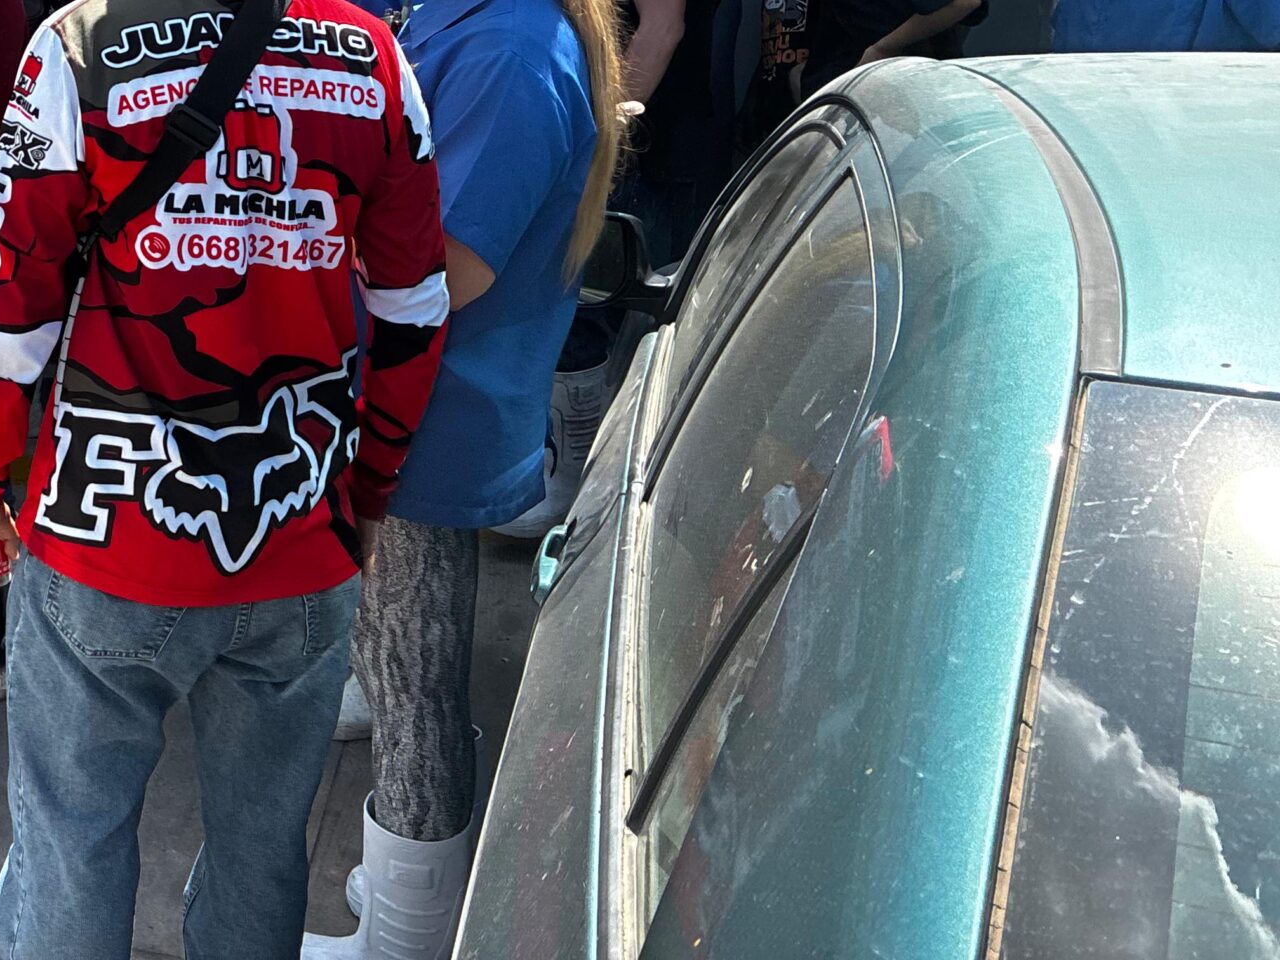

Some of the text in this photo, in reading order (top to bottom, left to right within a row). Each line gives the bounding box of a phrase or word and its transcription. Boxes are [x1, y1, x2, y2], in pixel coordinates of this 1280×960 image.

[259, 75, 379, 109] REPARTOS
[164, 192, 206, 214] LA
[172, 217, 193, 225] TUS
[254, 217, 268, 225] DE
